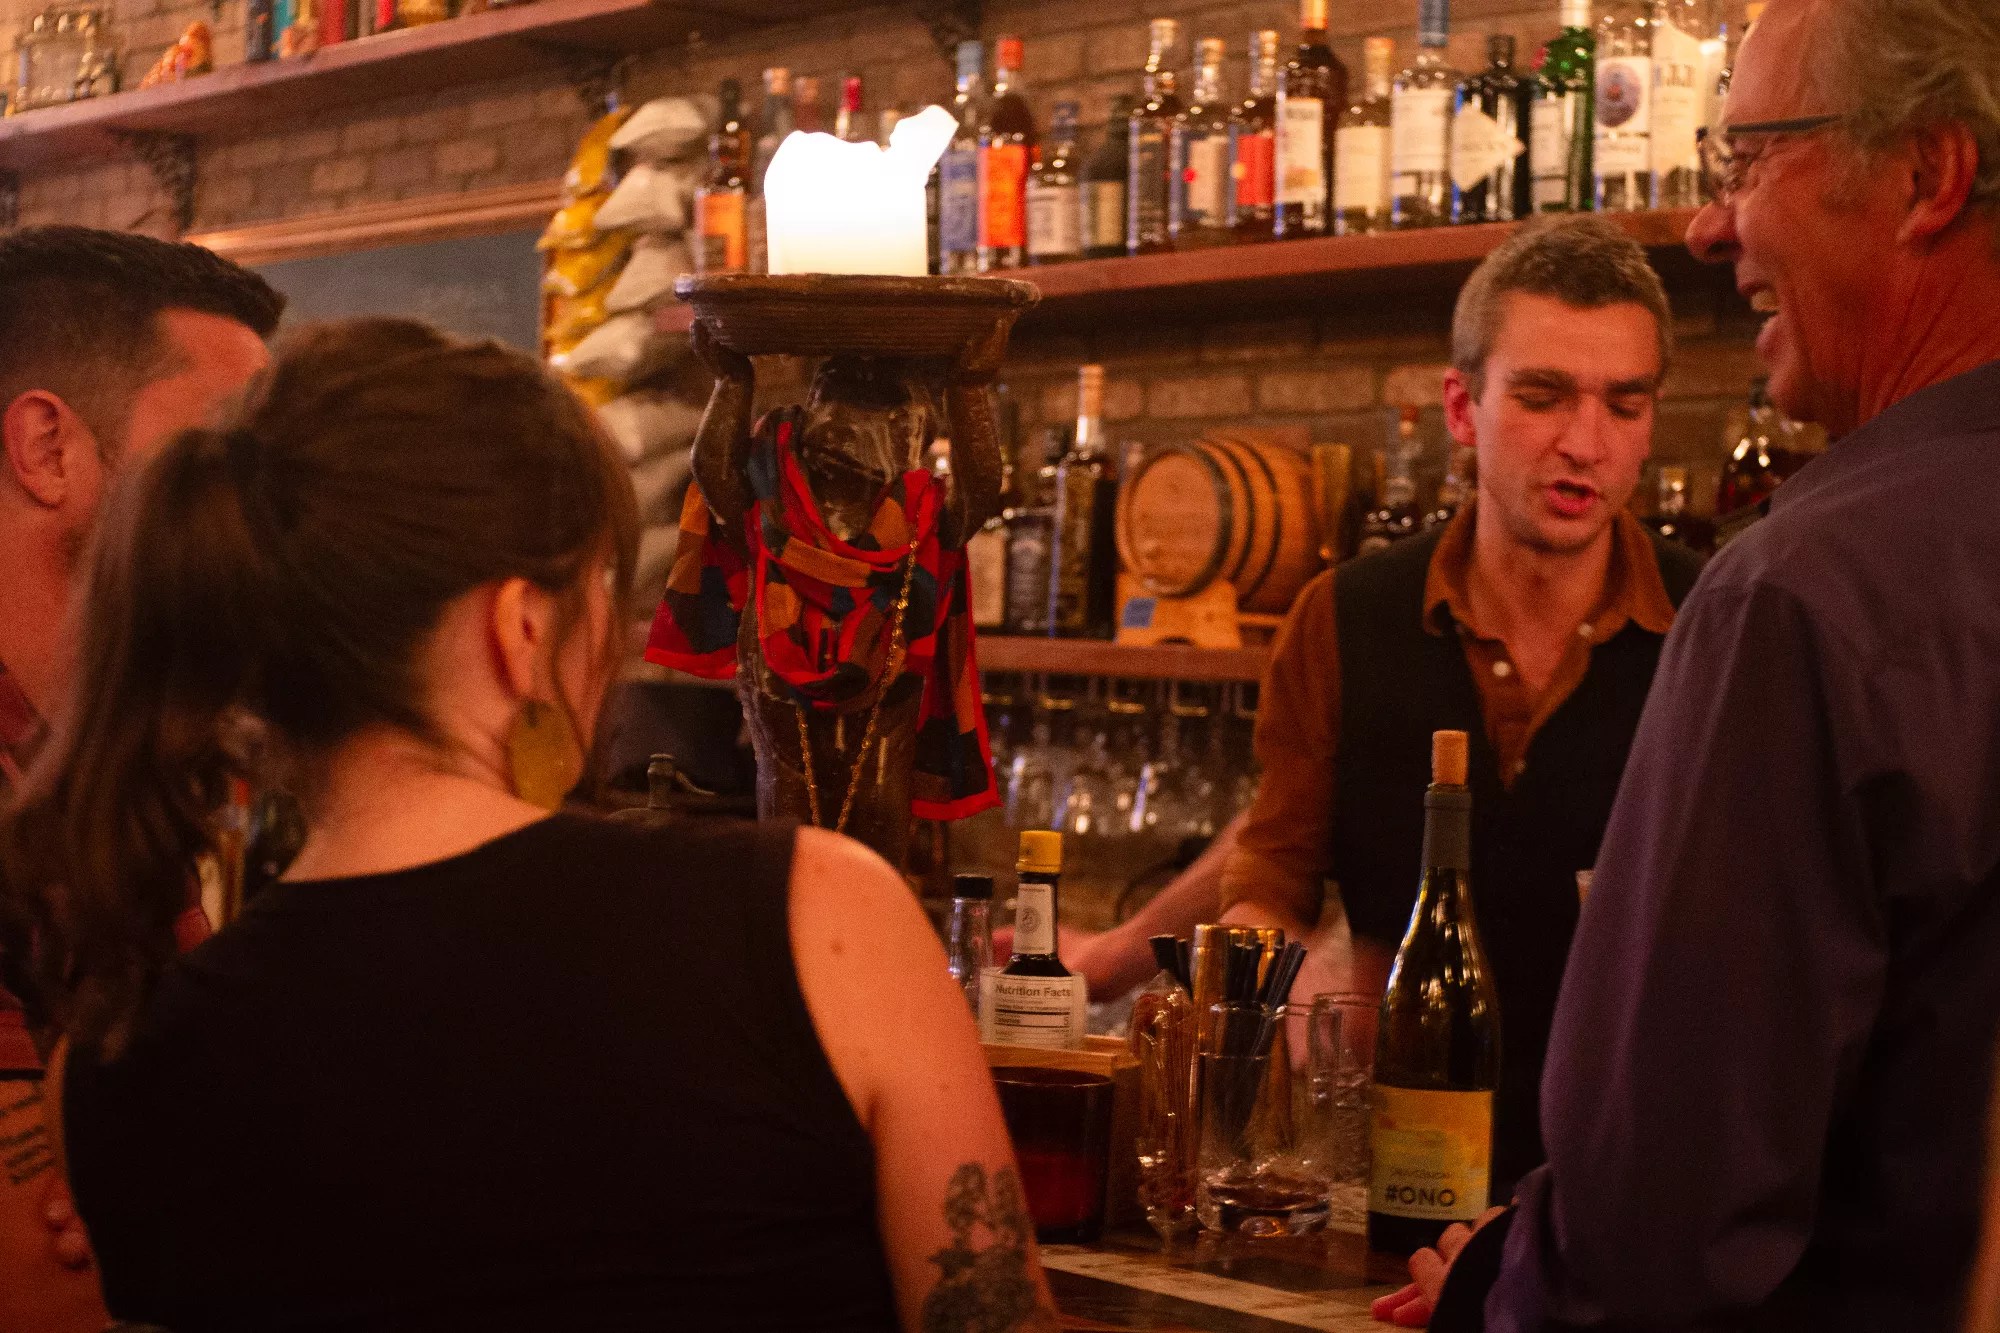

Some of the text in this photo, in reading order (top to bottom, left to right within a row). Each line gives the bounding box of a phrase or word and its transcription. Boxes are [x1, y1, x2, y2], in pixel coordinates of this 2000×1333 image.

[995, 984, 1072, 997] Nutrition Facts
[1385, 1184, 1456, 1207] #ONO
